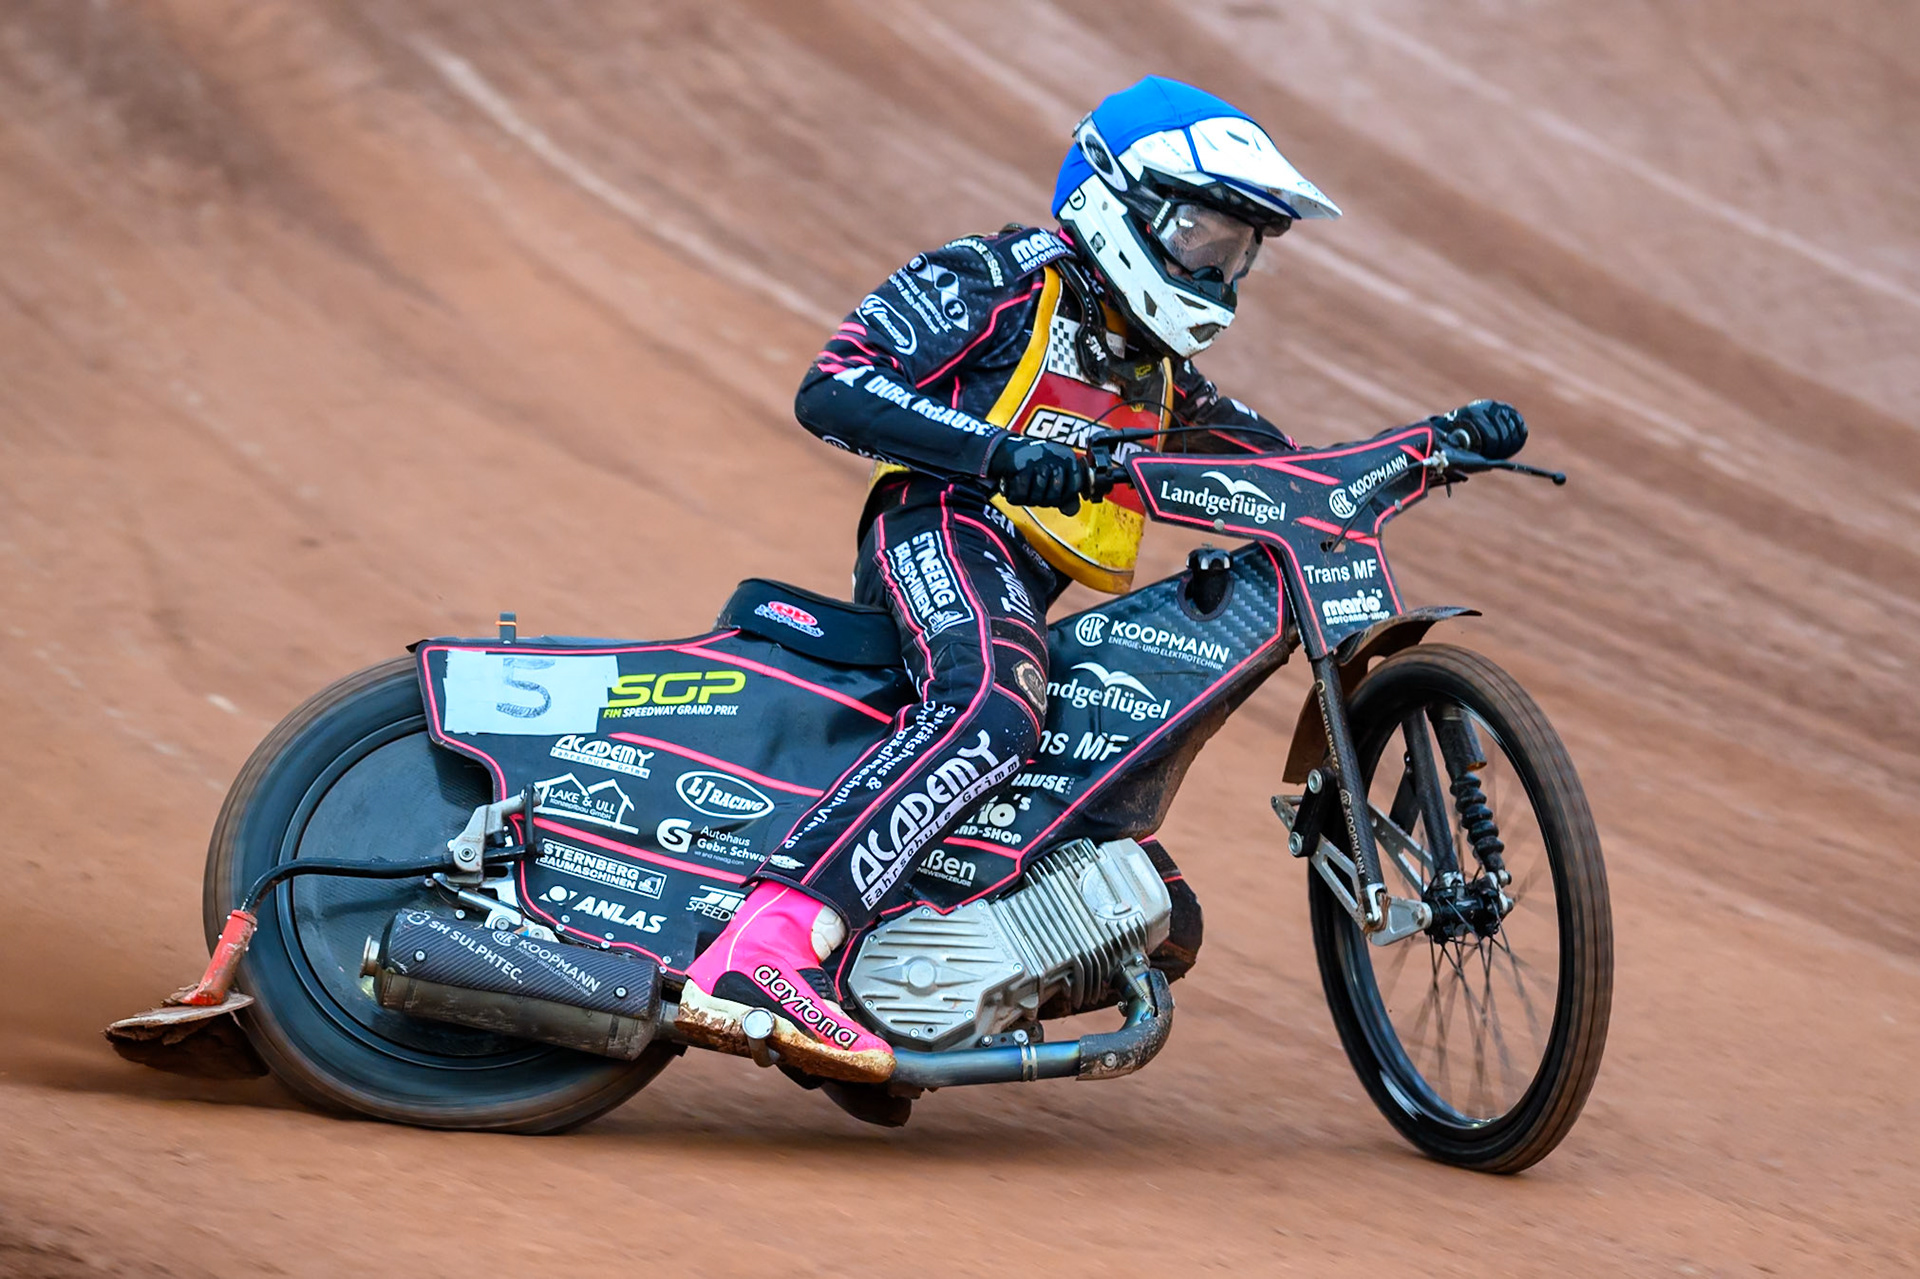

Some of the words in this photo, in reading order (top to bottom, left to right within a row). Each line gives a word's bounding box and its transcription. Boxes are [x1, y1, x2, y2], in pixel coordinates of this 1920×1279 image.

[1348, 453, 1408, 498] KOOPMANN
[1161, 481, 1286, 524] Landgeflügel
[1303, 565, 1350, 584] Trans
[1352, 558, 1376, 580] MF
[1322, 588, 1383, 617] mario's
[1111, 620, 1230, 664] KOOPMANN
[1143, 644, 1159, 655] UND
[1160, 649, 1224, 671] ELEKTROTECHNIK
[495, 657, 555, 718] 5
[608, 671, 746, 707] SGP
[1046, 678, 1171, 721] ndgeflügel
[603, 708, 622, 718] FIM
[622, 705, 676, 718] SPEEDWAY
[676, 705, 712, 715] GRAND
[713, 705, 738, 715] PRIX
[555, 735, 655, 767] ACADEMY
[1073, 731, 1130, 761] MF
[866, 776, 882, 790] &
[962, 761, 1018, 803] Grimm
[1011, 773, 1069, 793] AUSE
[549, 787, 580, 804] LAKE
[582, 796, 592, 807] &
[596, 799, 616, 815] ULL
[589, 808, 611, 820] GmbH
[708, 788, 765, 811] RACING
[851, 729, 999, 893] ACADEMY
[697, 838, 727, 855] Gebr.
[729, 846, 767, 863] Schwa
[700, 825, 750, 846] Autohaus
[543, 843, 640, 881] STERNBERG
[921, 849, 976, 880] ßen
[572, 895, 668, 934] ANLAS
[429, 920, 451, 934] SH
[450, 930, 523, 984] SULPHTEC.
[519, 940, 601, 993] KOOPMANN
[754, 965, 859, 1049] daytona
